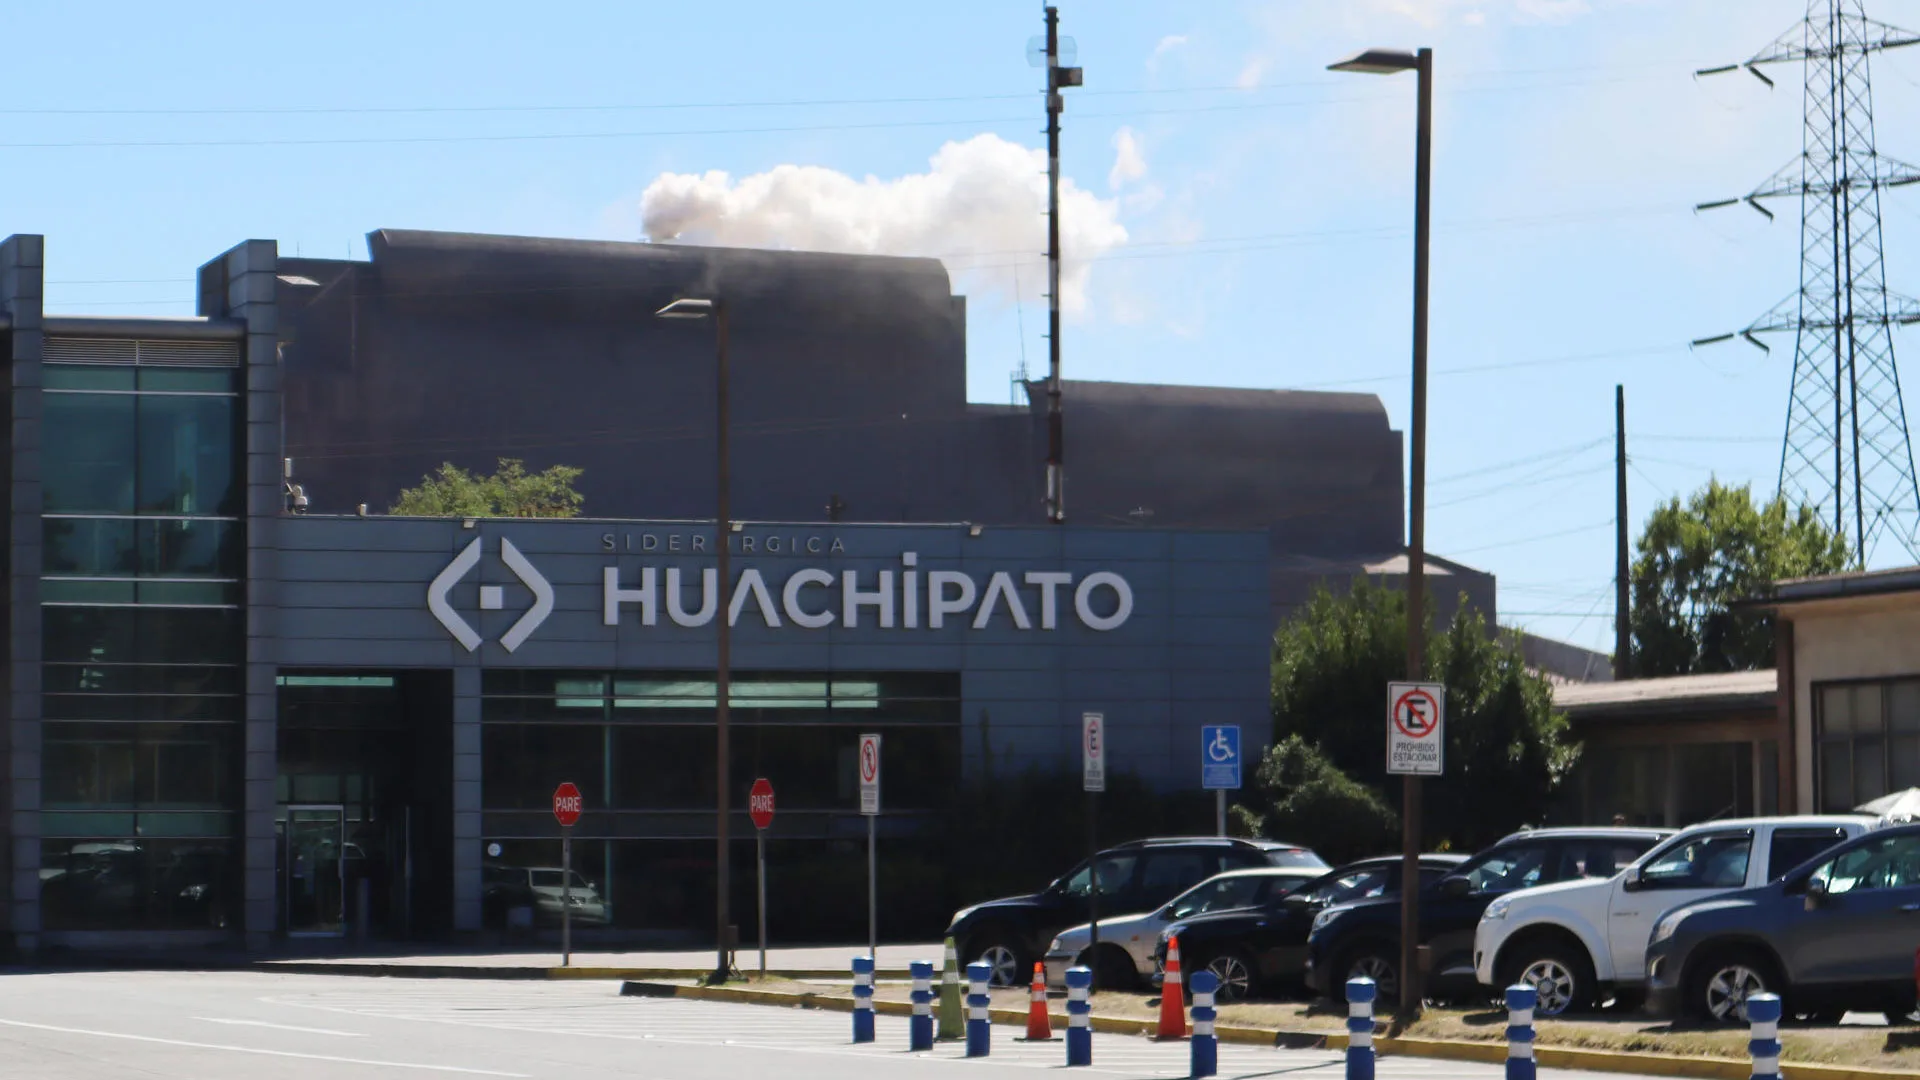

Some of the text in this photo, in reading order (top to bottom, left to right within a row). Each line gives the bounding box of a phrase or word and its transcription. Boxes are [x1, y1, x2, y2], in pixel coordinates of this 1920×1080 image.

[602, 534, 846, 553] SIDERRGICA
[1396, 742, 1436, 753] PROHIBIDO
[1393, 752, 1437, 762] ESTACIONAR
[555, 796, 580, 813] PARE
[751, 795, 774, 813] PARE
